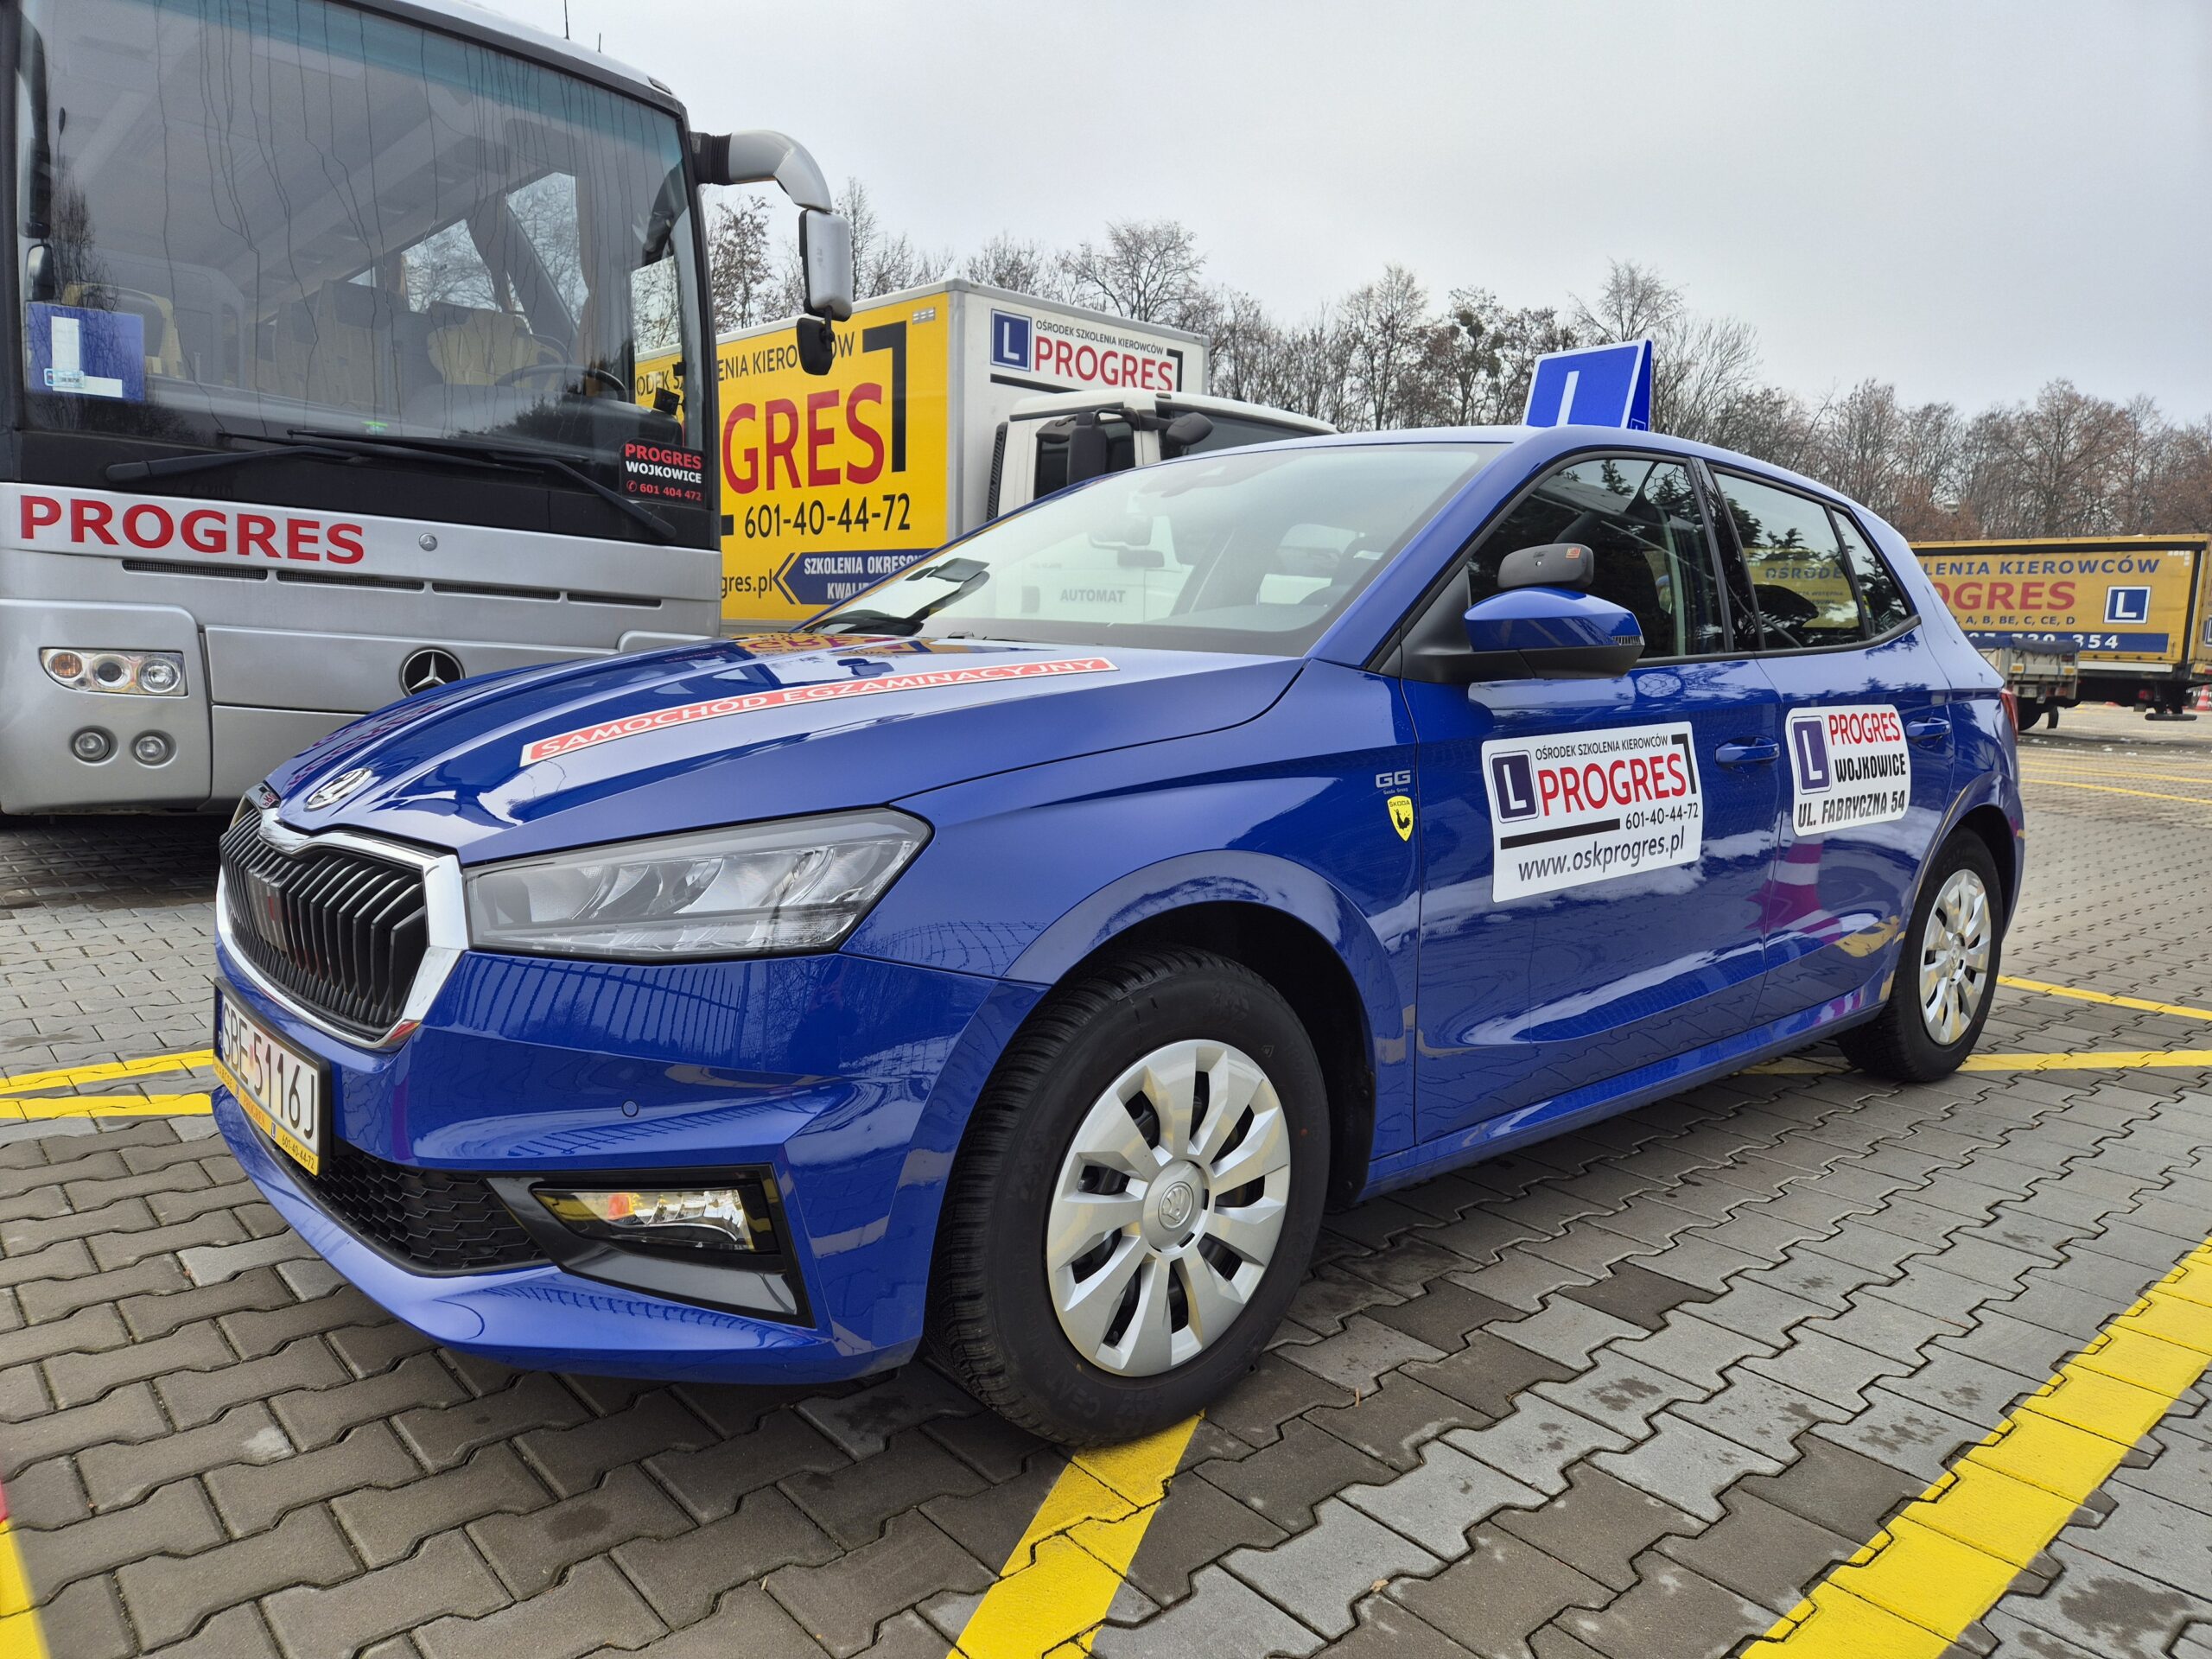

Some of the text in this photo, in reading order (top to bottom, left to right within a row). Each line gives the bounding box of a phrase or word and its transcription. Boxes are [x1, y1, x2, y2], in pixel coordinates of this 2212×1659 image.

[1003, 322, 1020, 360] L
[1036, 320, 1164, 356] OŚRODEK SZKOLENIA KIEROWCÓW
[51, 316, 123, 397] L
[1035, 335, 1173, 391] PROGRES
[625, 443, 702, 469] PROGRES
[626, 461, 702, 484] WOJKOWICE
[639, 484, 702, 501] 601 404 472
[20, 494, 364, 564] PROGRES
[745, 493, 911, 539] 601-40-44-72
[804, 556, 864, 575] SZKOLENIA
[1999, 555, 2160, 576] KIEROWCÓW
[1059, 589, 1126, 603] AUTOMAT
[2114, 592, 2138, 618] L
[1999, 616, 2018, 626] BE,
[2024, 616, 2035, 626] C,
[2040, 616, 2060, 626] CE,
[2066, 616, 2075, 625] D
[540, 660, 1096, 757] SAMOCHÓD EGZAMINACYJNY
[1828, 712, 1901, 746] PROGRES
[1535, 733, 1669, 761] OŚRODEK SZKOLENIA KIEROWCÓW
[1802, 730, 1823, 780] L
[1376, 770, 1411, 788] GG
[1537, 753, 1687, 817] PROGRES
[1834, 753, 1906, 783] WOJKOWICE
[1503, 764, 1528, 810] L
[1625, 802, 1699, 830] 601-40-44-72
[1797, 790, 1905, 828] UL. FABRYCZNA 54
[1518, 825, 1685, 881] www.oskprogres.pl
[224, 1002, 315, 1140] SBE 5116J
